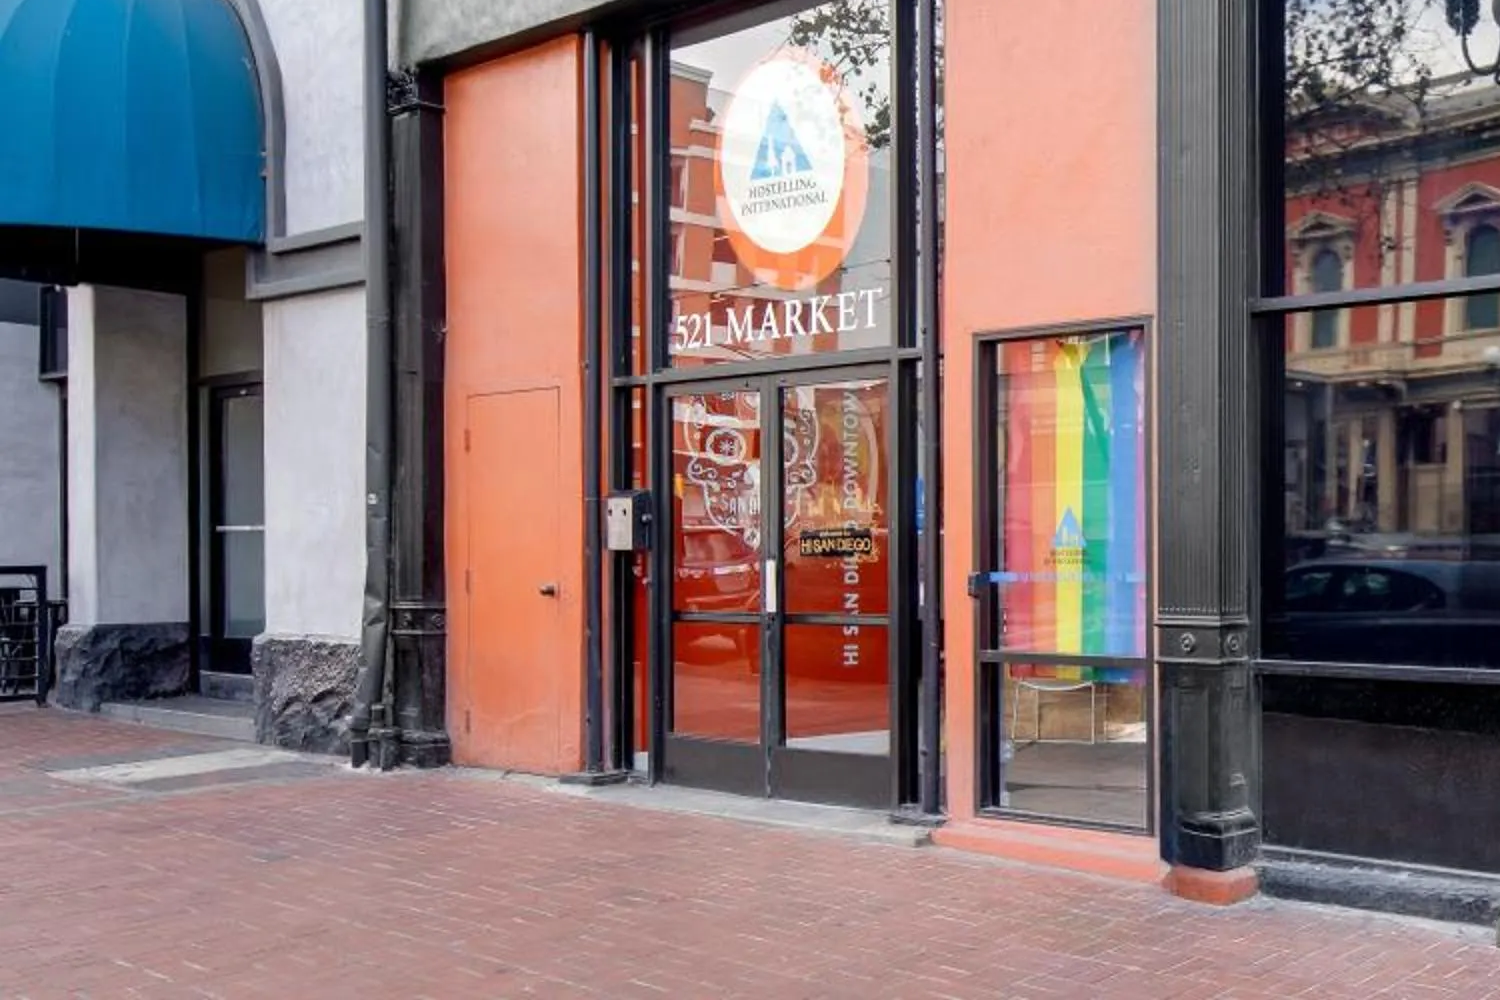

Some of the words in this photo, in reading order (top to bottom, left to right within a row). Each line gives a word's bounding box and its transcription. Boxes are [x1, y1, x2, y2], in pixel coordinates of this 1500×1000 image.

[749, 178, 816, 199] HOSTELLING
[741, 190, 828, 216] INTERNATIONAL
[676, 312, 713, 349] 521
[726, 287, 883, 344] MARKET
[844, 391, 859, 509] DOWNTOW
[801, 538, 812, 553] HI
[814, 537, 835, 552] SAN
[838, 536, 871, 551] DIEGO
[843, 643, 859, 666] HI
